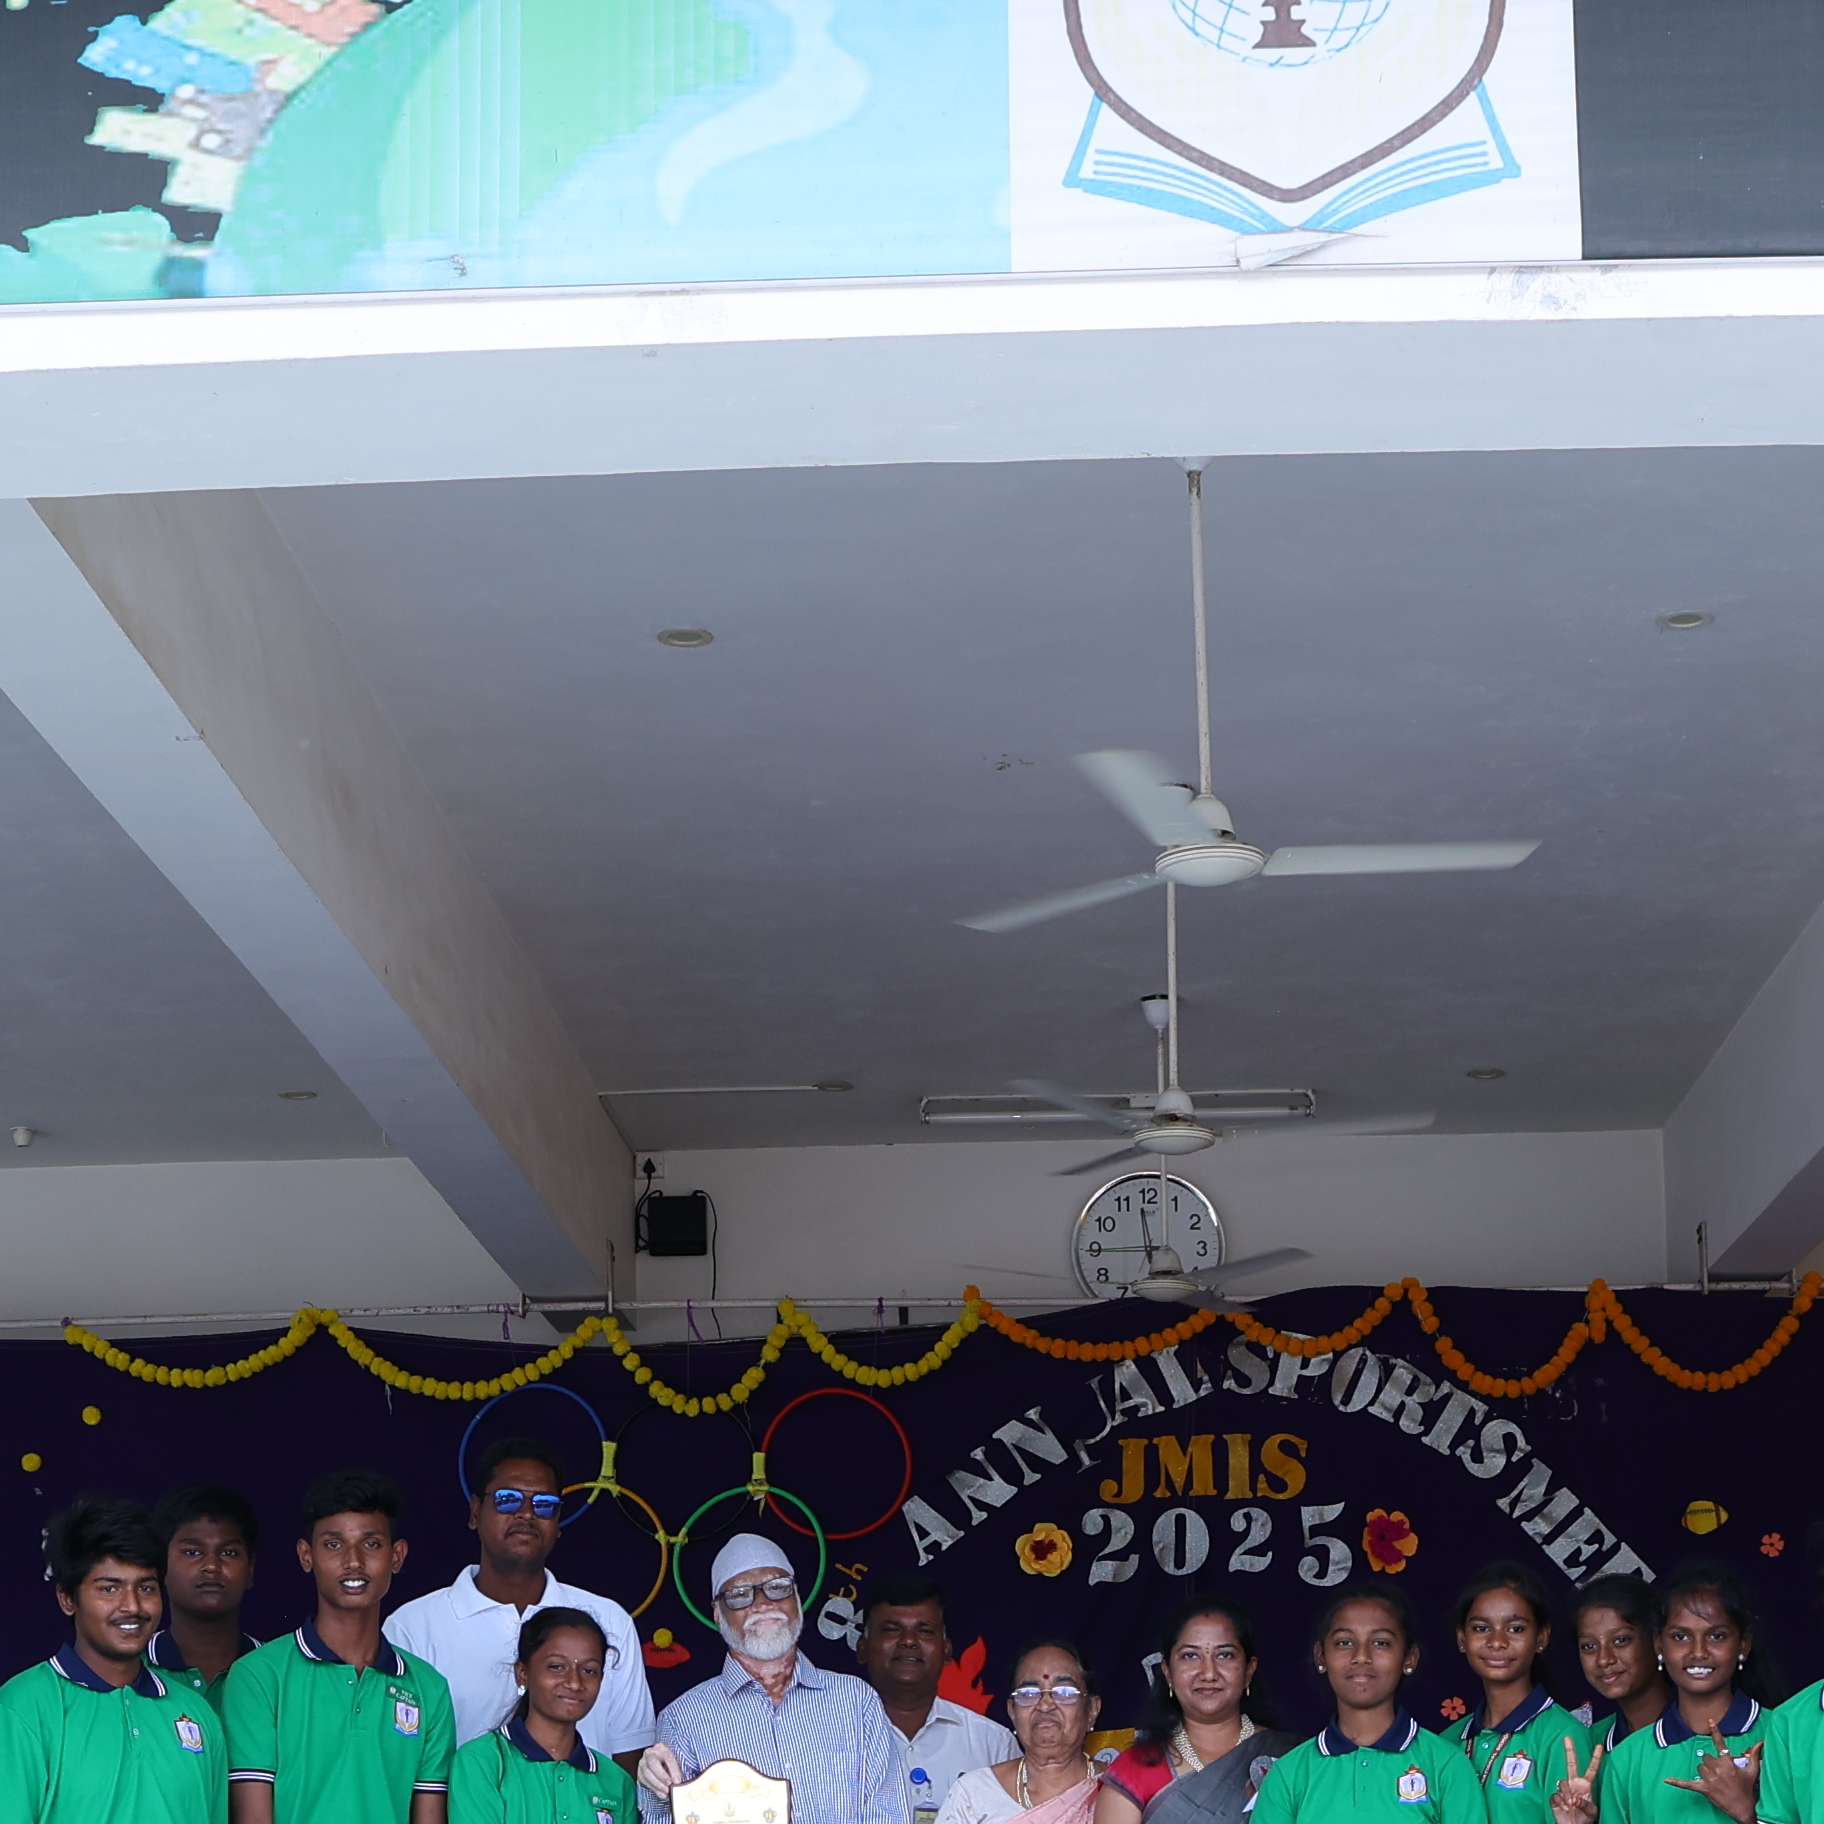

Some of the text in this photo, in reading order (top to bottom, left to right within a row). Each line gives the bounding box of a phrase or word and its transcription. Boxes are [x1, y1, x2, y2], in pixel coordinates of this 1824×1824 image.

[1114, 1195, 1131, 1212] 11
[1138, 1187, 1158, 1204] 12
[1170, 1195, 1179, 1212] 1
[1095, 1216, 1116, 1232] 10
[1189, 1213, 1202, 1230] 2
[1089, 1240, 1102, 1257] 9
[1196, 1240, 1208, 1257] 3
[1096, 1267, 1109, 1283] 8
[1099, 1433, 1308, 1504] JMIS
[1222, 1330, 1532, 1479] SPORTS
[1495, 1457, 1657, 1590] ME
[1081, 1502, 1354, 1587] 2025
